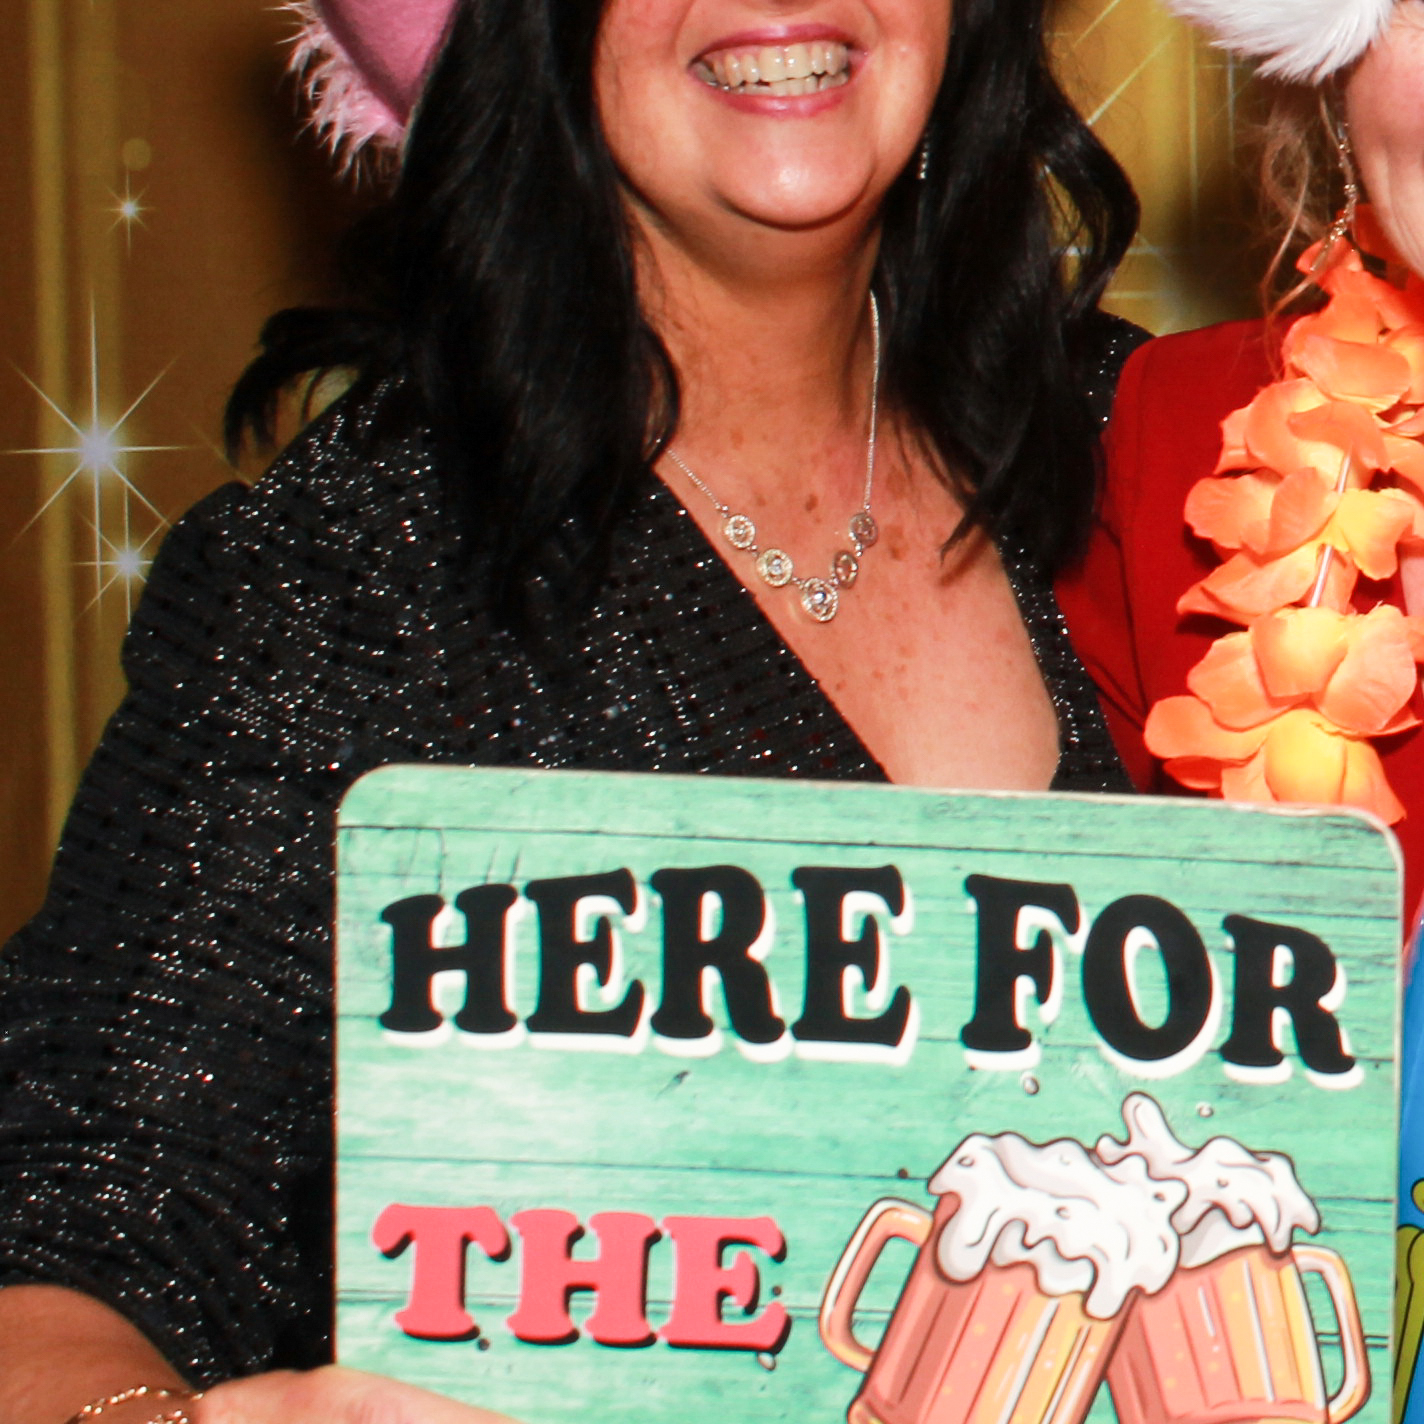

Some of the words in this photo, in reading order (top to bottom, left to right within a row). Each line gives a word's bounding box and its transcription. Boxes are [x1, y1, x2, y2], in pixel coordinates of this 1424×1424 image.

[379, 865, 914, 1054] HERE
[961, 873, 1358, 1078] FOR
[372, 1202, 793, 1353] THE
